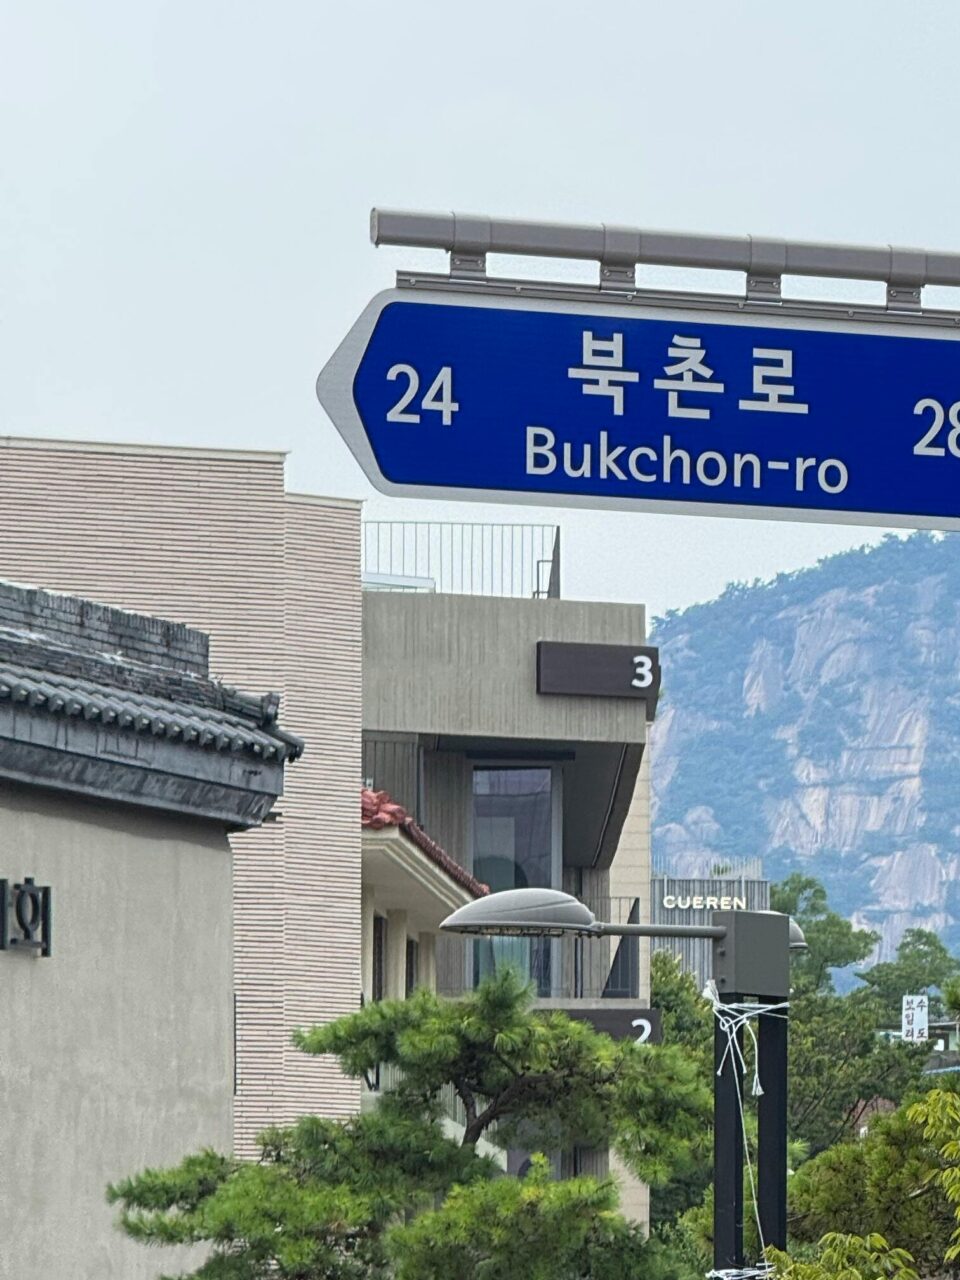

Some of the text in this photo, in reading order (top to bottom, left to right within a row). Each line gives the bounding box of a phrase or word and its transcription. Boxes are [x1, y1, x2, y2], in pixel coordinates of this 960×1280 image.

[386, 364, 459, 425] 24
[568, 331, 809, 420] 북촌로
[526, 426, 848, 494] Bukchon-ro
[632, 655, 653, 688] 3
[0, 877, 51, 957] 회
[663, 896, 747, 910] CUEREN
[631, 1018, 652, 1042] 2
